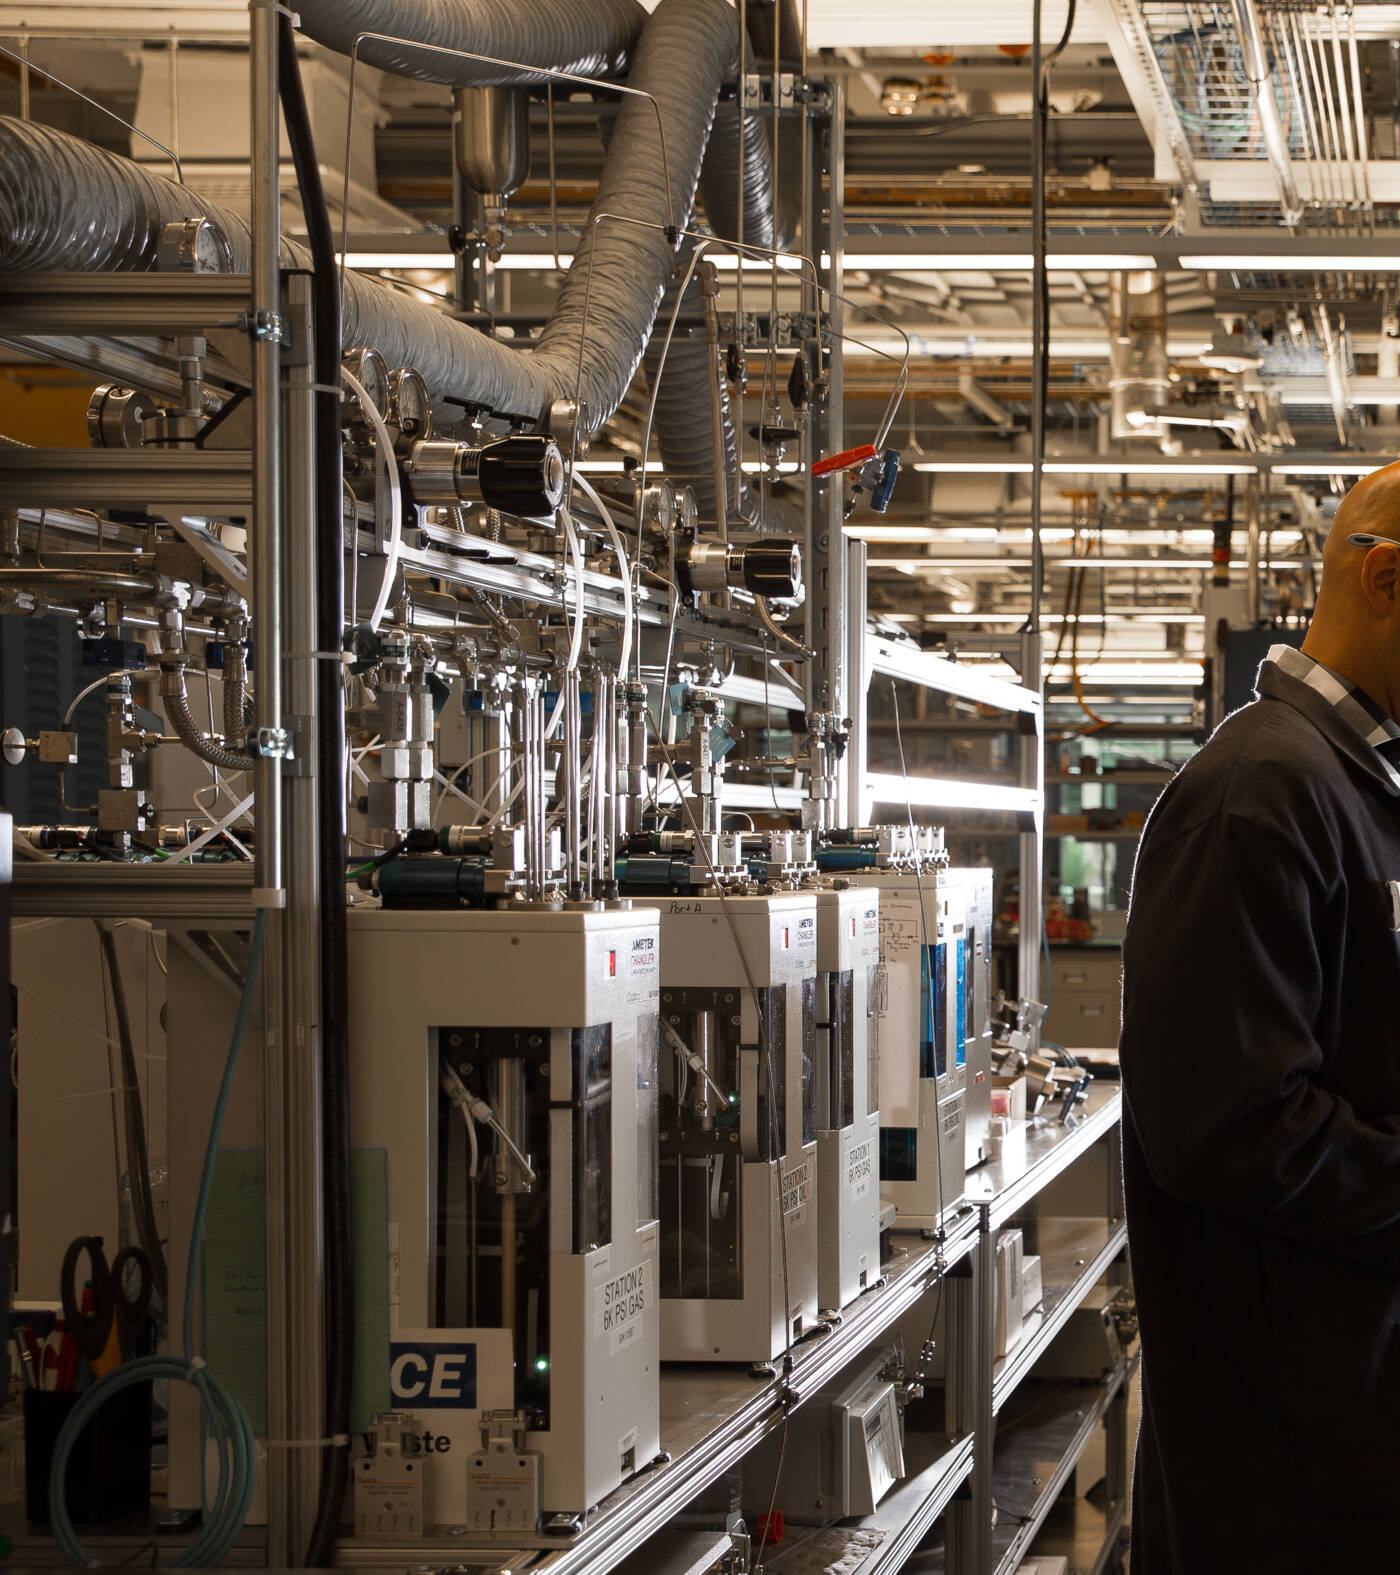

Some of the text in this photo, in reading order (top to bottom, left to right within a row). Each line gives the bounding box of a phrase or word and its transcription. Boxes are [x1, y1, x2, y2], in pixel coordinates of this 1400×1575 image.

[670, 901, 702, 913] Port A
[631, 938, 655, 951] AMETEK
[605, 1266, 643, 1305] STATION 2
[603, 1289, 645, 1331] 6K PSI GAS
